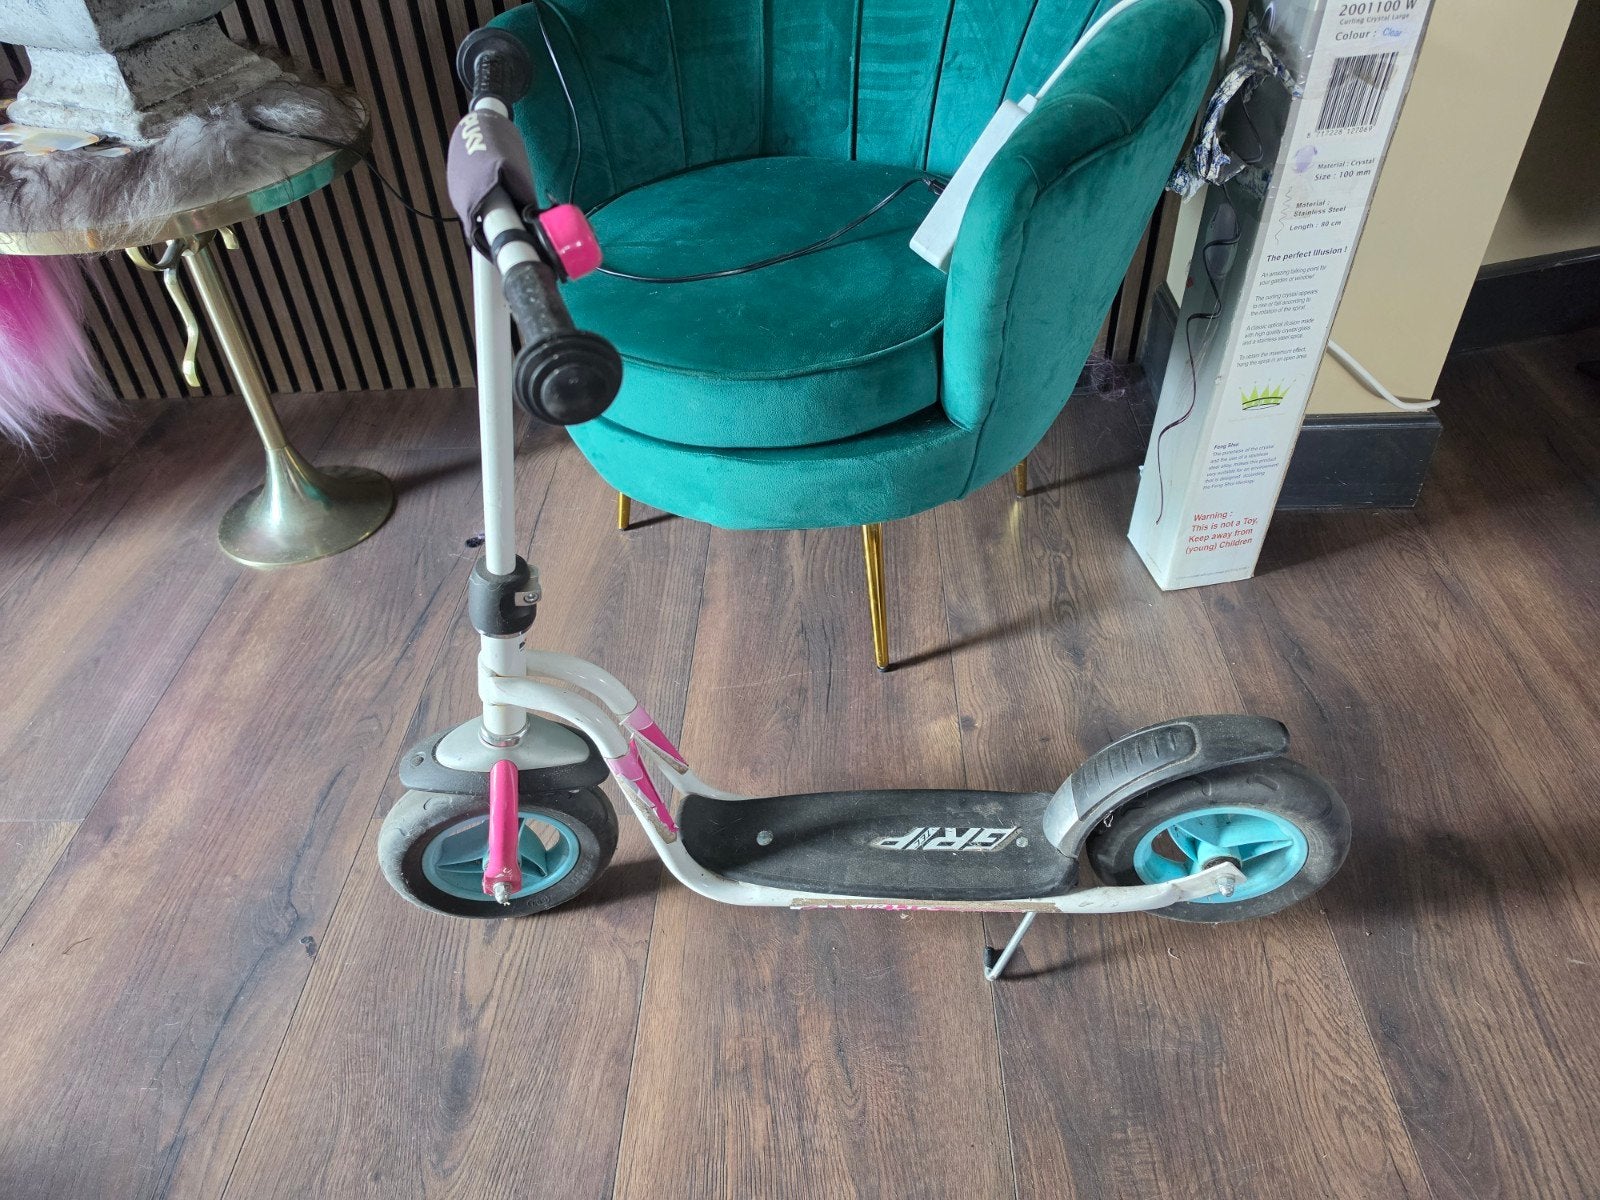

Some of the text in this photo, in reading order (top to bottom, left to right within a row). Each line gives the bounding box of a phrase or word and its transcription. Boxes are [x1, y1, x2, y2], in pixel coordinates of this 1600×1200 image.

[1339, 0, 1418, 16] 2001100 W
[1367, 14, 1390, 23] Crystal
[1335, 31, 1370, 41] Colour
[1318, 161, 1344, 169] Material
[1351, 158, 1374, 166] Crystal
[1340, 170, 1353, 178] 100
[1294, 209, 1325, 217] Stainless
[1290, 223, 1313, 231] Length
[1283, 251, 1311, 261] perfect
[1313, 248, 1342, 256] Illusion
[1194, 512, 1228, 521] Warning
[1192, 524, 1208, 532] This
[1189, 528, 1252, 543] Keep away from
[1186, 538, 1252, 554] (young) Children
[872, 827, 1019, 851] GRIP
